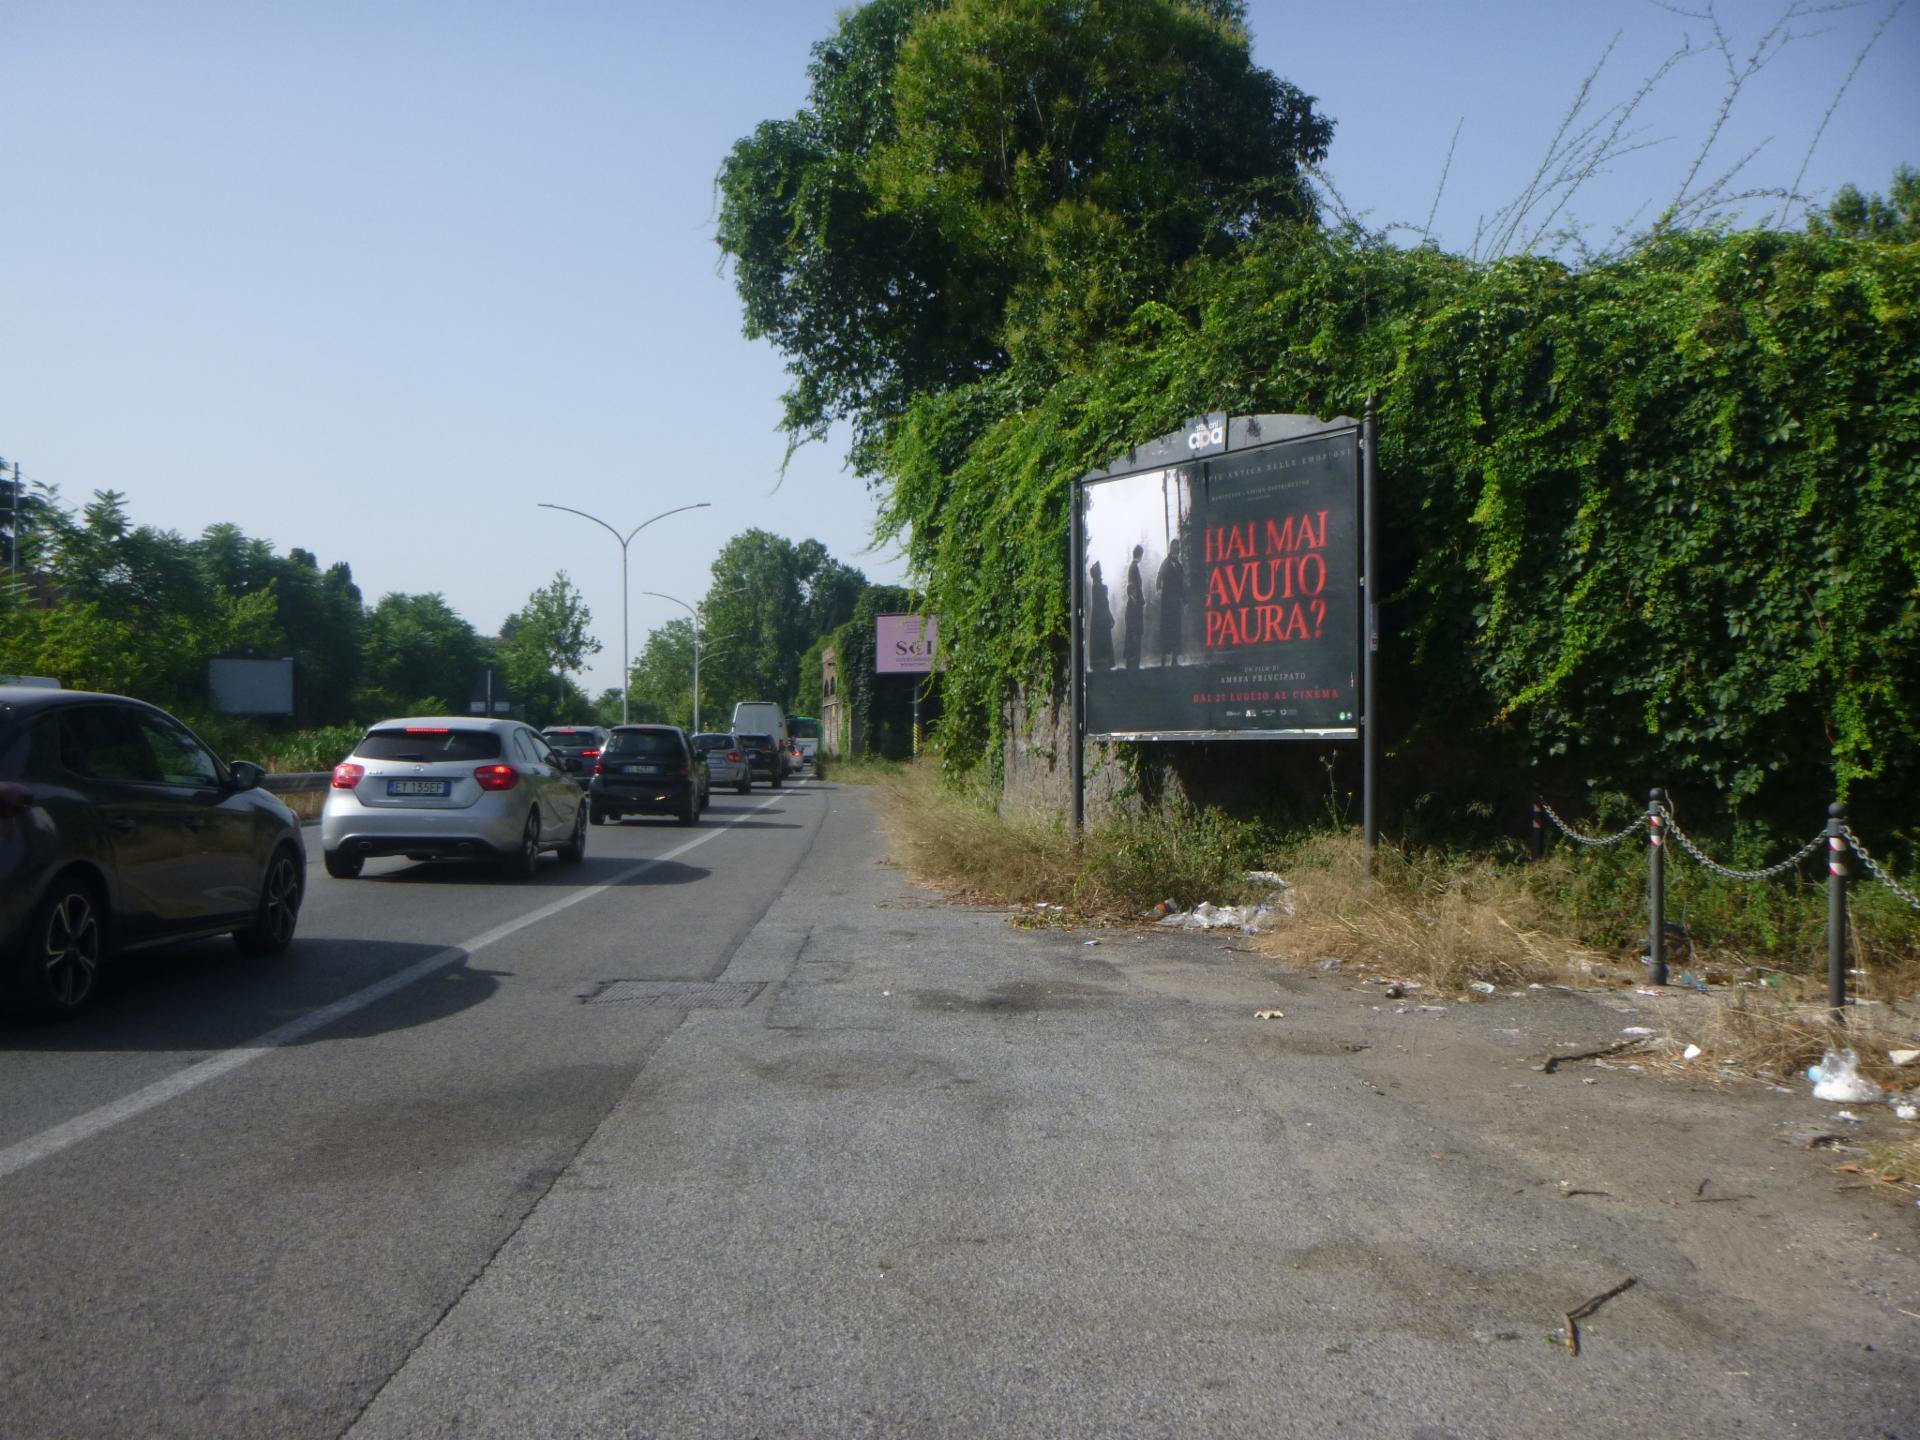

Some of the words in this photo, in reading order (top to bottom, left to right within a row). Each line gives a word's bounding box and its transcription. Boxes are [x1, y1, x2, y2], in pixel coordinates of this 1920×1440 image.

[1204, 521, 1257, 563] HAI
[1265, 510, 1329, 555] MAI
[1205, 552, 1327, 607] AVUTO
[1205, 599, 1327, 648] PAURA?
